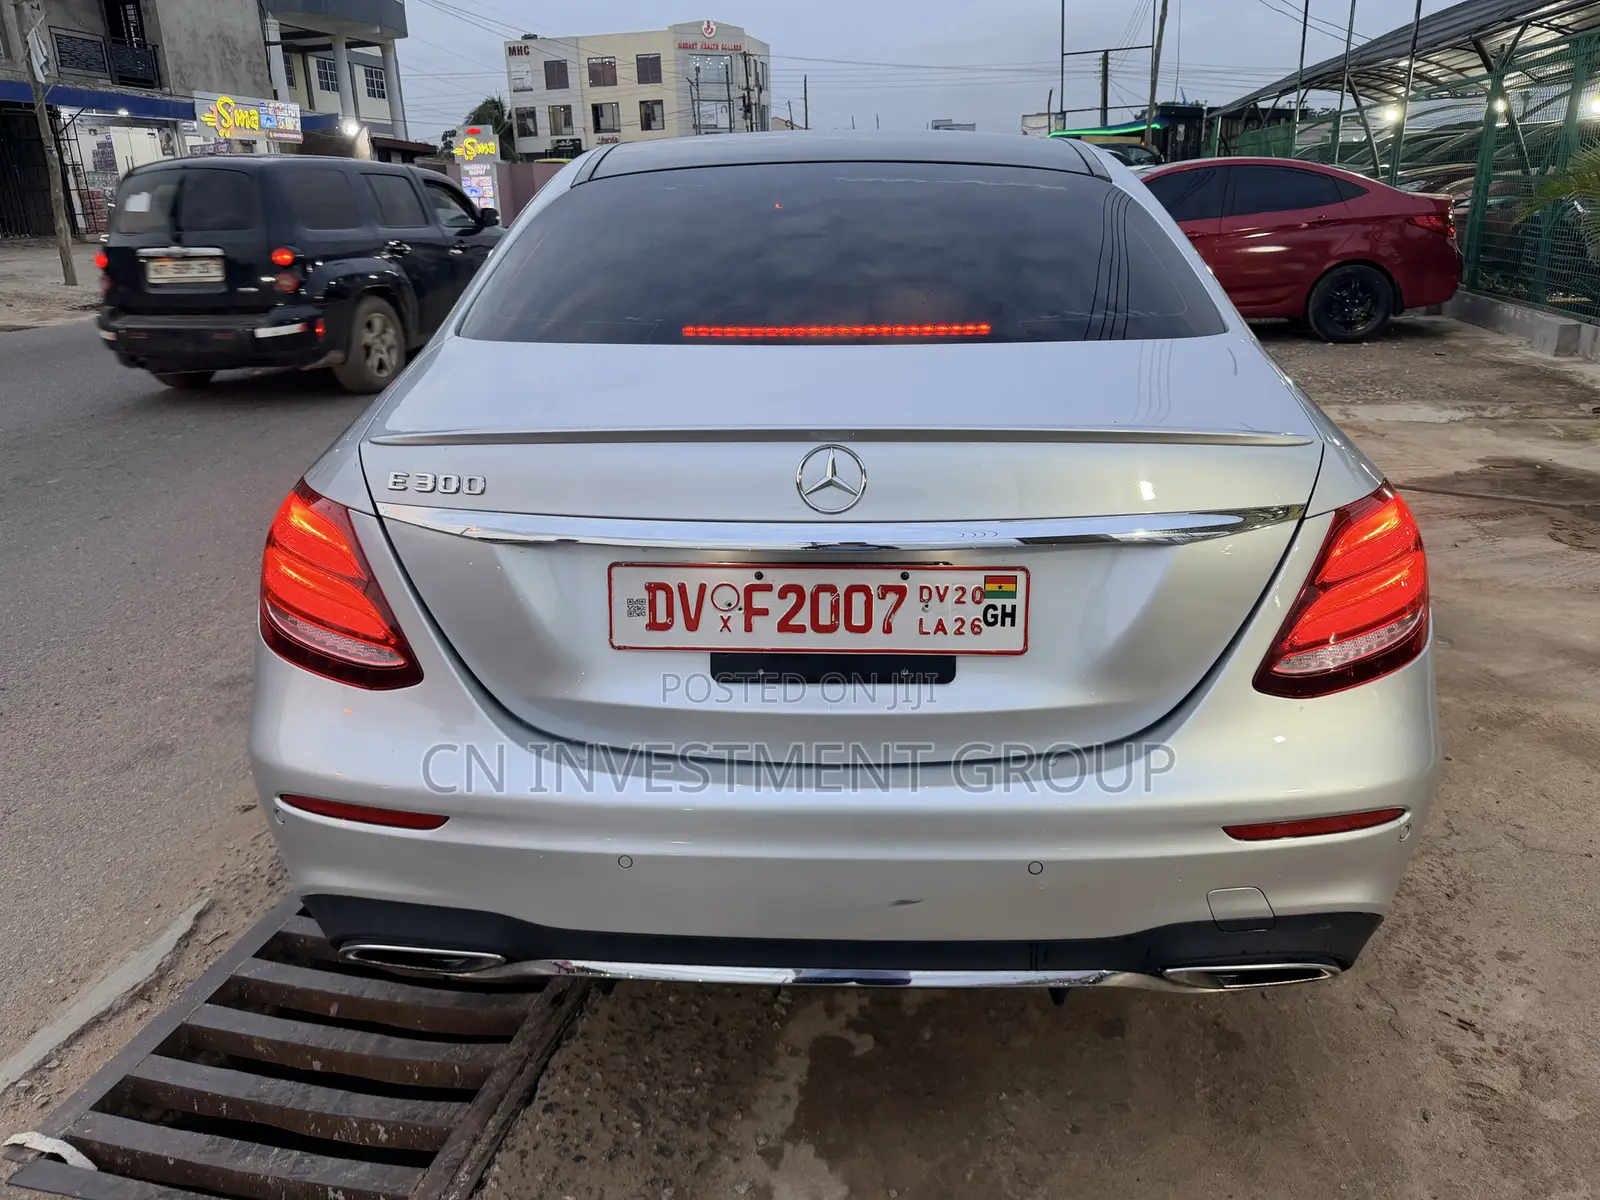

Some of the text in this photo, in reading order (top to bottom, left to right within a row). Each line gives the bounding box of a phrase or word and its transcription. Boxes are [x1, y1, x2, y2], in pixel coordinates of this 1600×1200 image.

[508, 45, 530, 56] MHC
[388, 471, 486, 495] E 300
[645, 582, 908, 634] DV F2007
[982, 603, 1016, 627] GH
